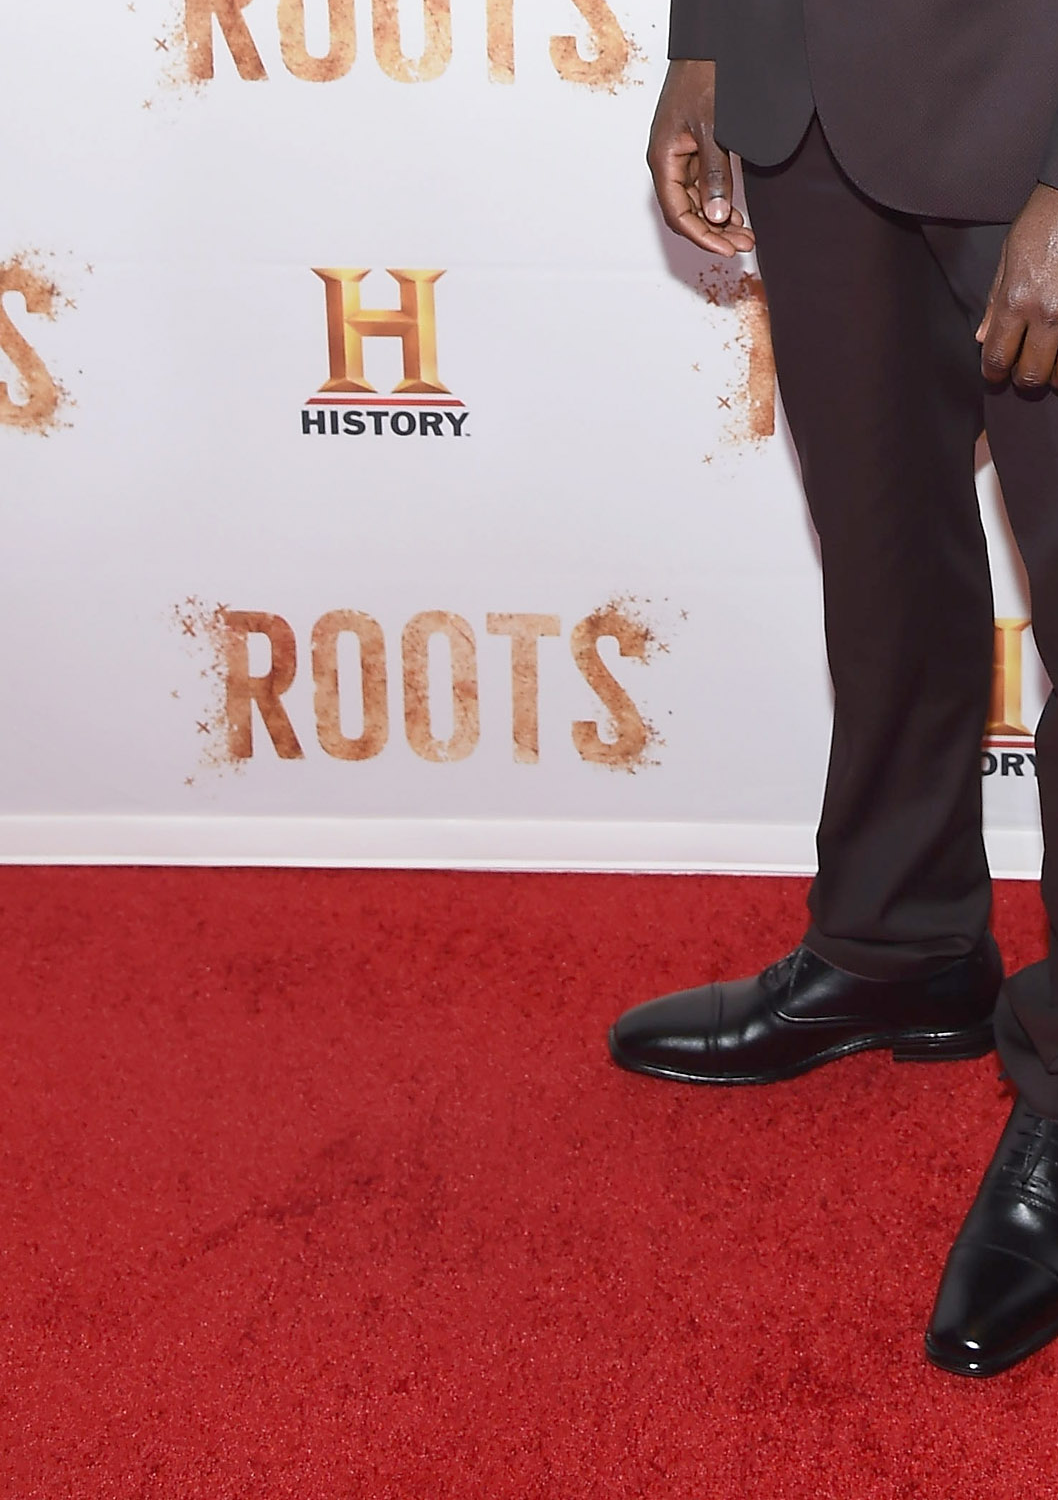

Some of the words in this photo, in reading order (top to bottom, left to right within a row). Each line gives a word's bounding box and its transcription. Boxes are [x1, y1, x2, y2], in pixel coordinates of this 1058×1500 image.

[311, 267, 451, 396] H
[301, 409, 470, 437] HISTORY
[224, 607, 650, 769] ROOTS
